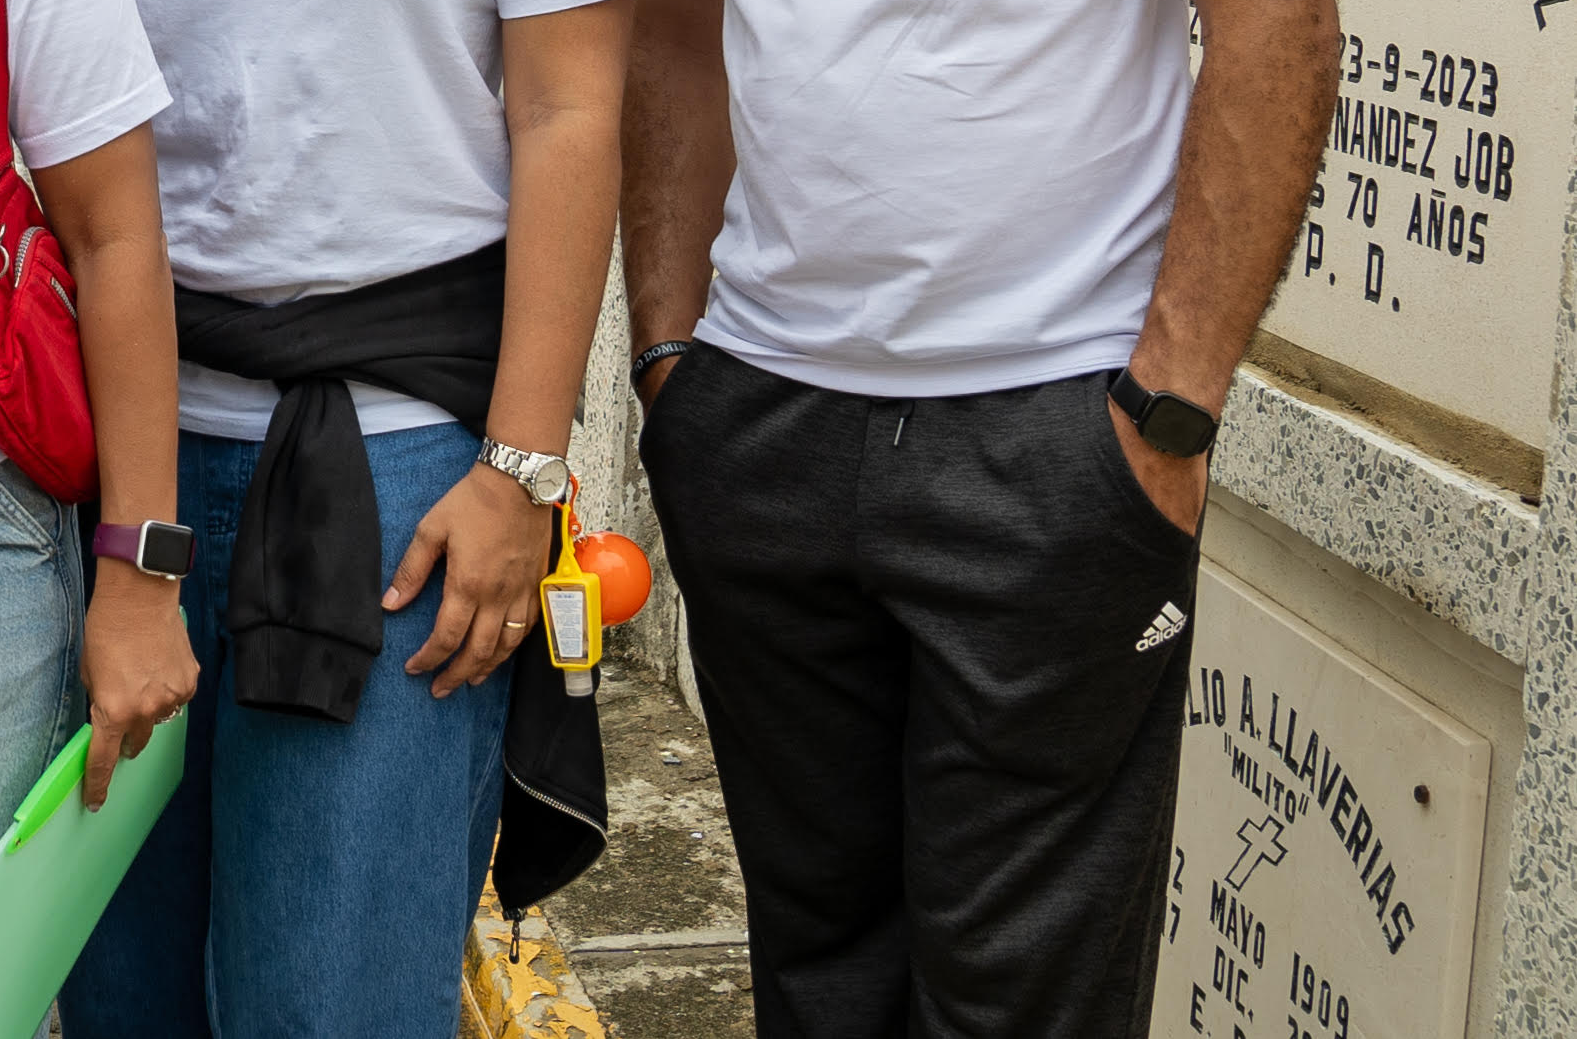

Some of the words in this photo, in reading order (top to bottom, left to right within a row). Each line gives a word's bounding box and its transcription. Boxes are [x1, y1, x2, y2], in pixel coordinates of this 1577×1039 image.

[1333, 95, 1438, 181] NANDEZ
[1454, 127, 1514, 202] JOB
[1305, 221, 1335, 286] P.
[1364, 242, 1400, 312] D.
[1346, 171, 1378, 228] 70
[1406, 188, 1488, 264] AÑOS
[1186, 667, 1226, 727] LIO
[1240, 674, 1261, 741] A.
[1268, 692, 1415, 955] LLAVERIAS
[1224, 731, 1309, 824] "MILITO"
[1166, 901, 1180, 944] 7
[1213, 945, 1254, 1023] DIC.
[1210, 879, 1265, 969] MAYO
[1290, 951, 1349, 1039] 1909
